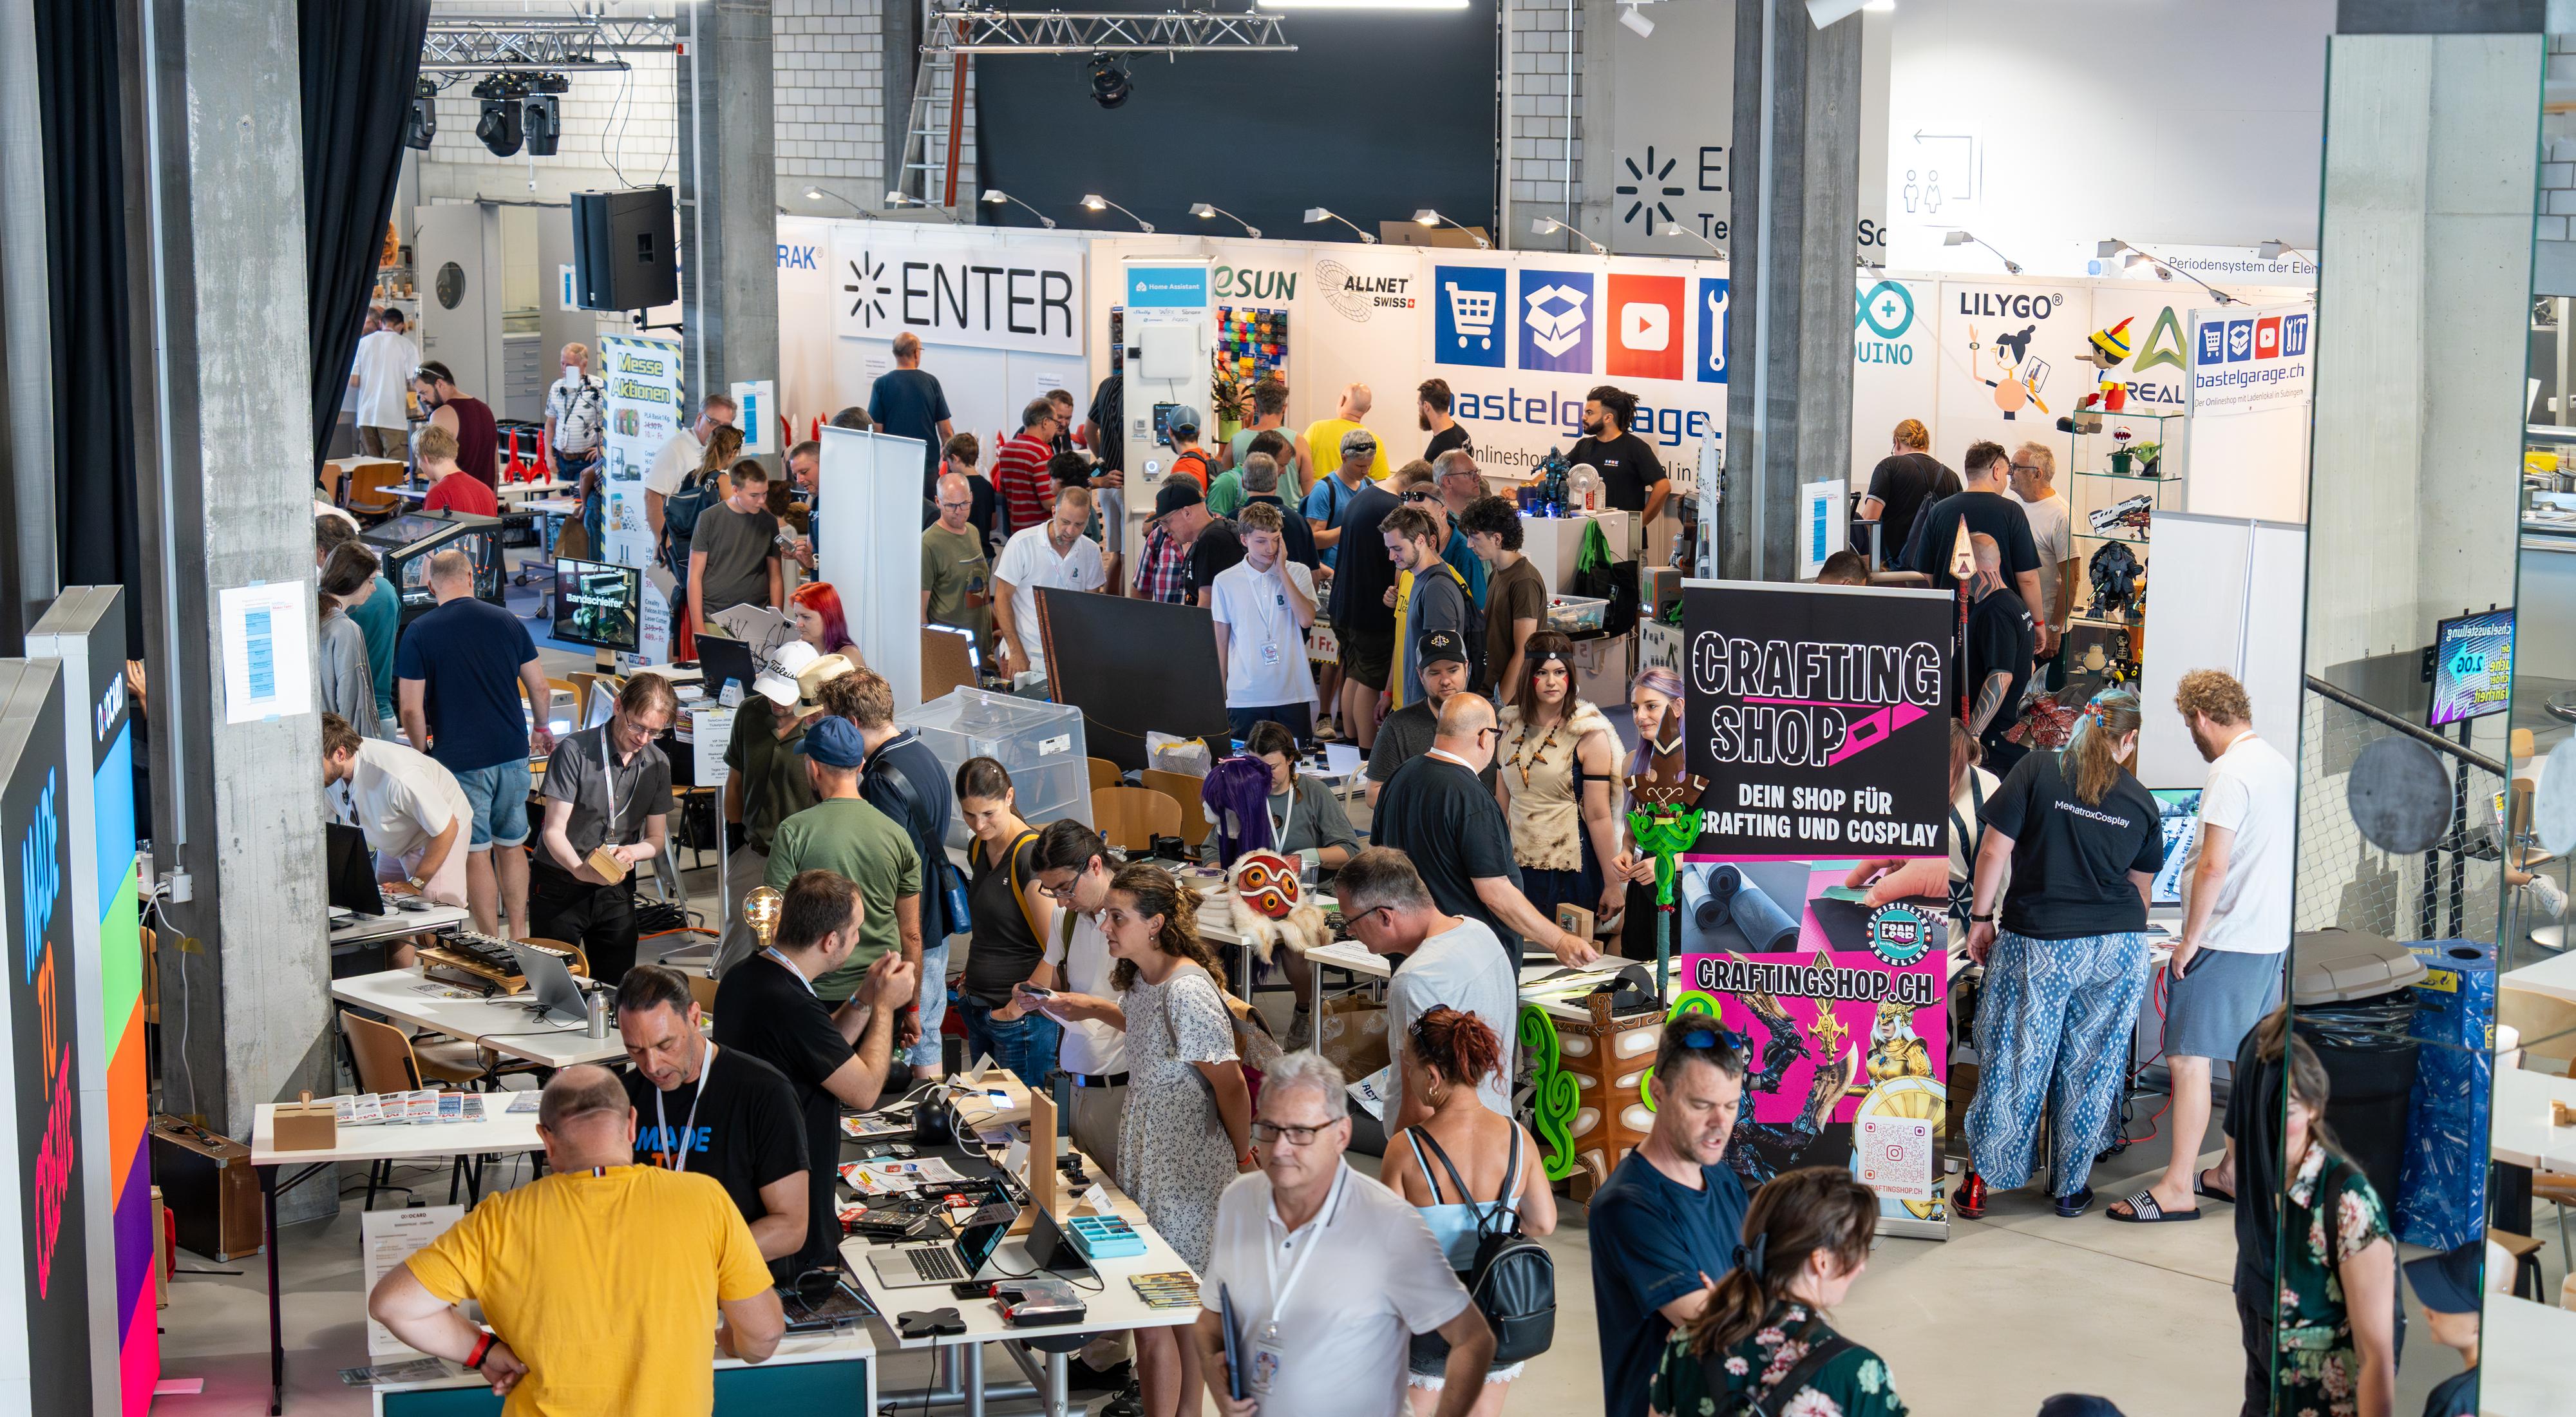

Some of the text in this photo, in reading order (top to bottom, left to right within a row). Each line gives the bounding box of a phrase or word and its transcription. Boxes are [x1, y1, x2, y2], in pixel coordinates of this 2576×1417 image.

[2169, 257, 2318, 274] Periodensystem der Ele
[903, 262, 1072, 338] ENTER
[1374, 296, 1406, 309] SWISS
[618, 352, 663, 377] Messe
[1855, 341, 1913, 365] UINO
[2197, 363, 2304, 388] bastelgarage.ch
[611, 377, 670, 404] Aktionen
[2195, 399, 2204, 407] Der
[2206, 395, 2237, 406] Onlineshop
[2238, 394, 2246, 403] mit
[2247, 391, 2274, 402] Ladenlokal
[2280, 388, 2303, 399] Subingen
[1677, 462, 1691, 481] in
[566, 593, 623, 608] Bandschleifer
[645, 598, 660, 608] Creality
[1276, 594, 1285, 605] B
[1319, 636, 1334, 652] Fr.
[1692, 631, 1940, 706] CRAFTING
[1711, 705, 1847, 766] SHOP
[1739, 783, 1893, 815] DEIN SHOP FÜR
[1799, 816, 1840, 841] UND
[1847, 819, 1939, 848] COSPLAY
[23, 765, 59, 985] MADE
[1868, 902, 1931, 933] OFFIZIELLER
[1881, 923, 1915, 932] FOAM
[1881, 931, 1915, 939] LORD
[1868, 940, 1929, 966] RESELLER
[1695, 957, 1934, 1004] CRAFTINGSHOP.CH
[38, 940, 57, 1102] TO
[635, 1125, 712, 1152] MADE
[35, 1041, 74, 1300] CREATE
